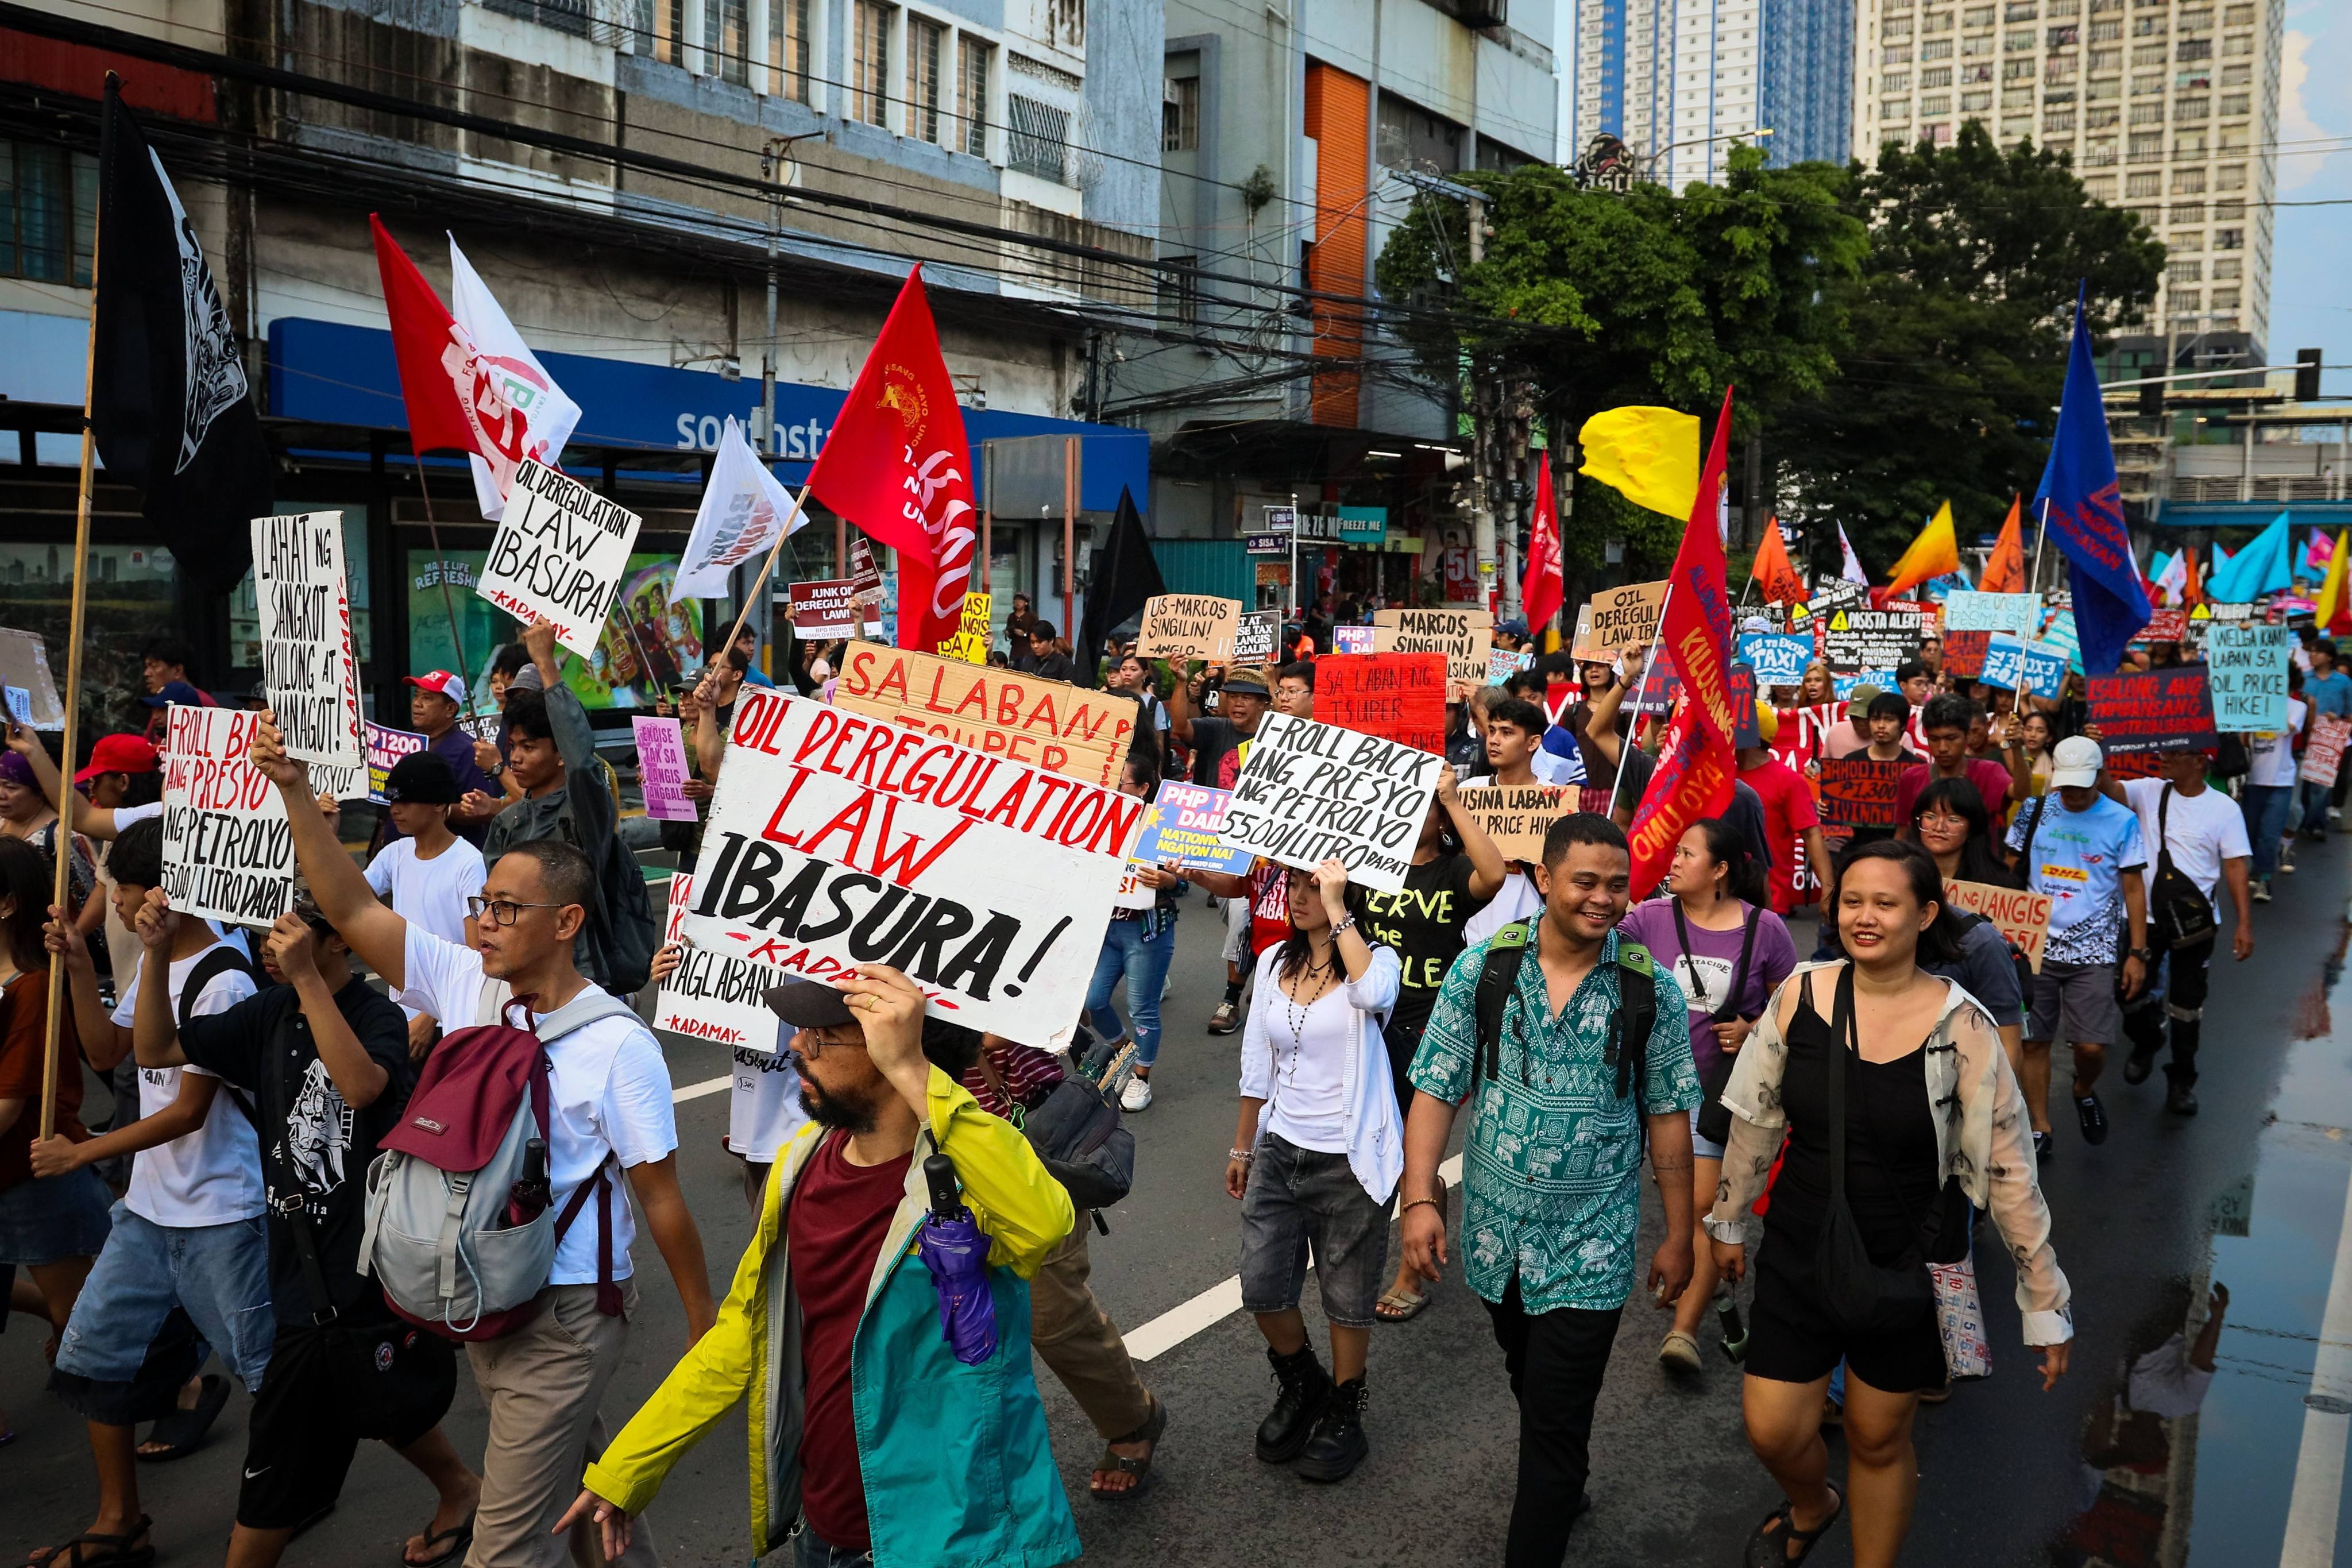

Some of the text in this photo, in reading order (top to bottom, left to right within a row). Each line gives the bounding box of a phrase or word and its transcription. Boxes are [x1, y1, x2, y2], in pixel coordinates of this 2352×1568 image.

[516, 459, 631, 539] OIL DEREGULATION
[521, 495, 603, 561] LAW
[261, 515, 332, 584] LAHAT NG
[1258, 538, 1275, 547] SISA
[423, 561, 470, 573] MAE LIFE
[489, 526, 619, 624] IBASURA!
[812, 586, 839, 598] JUNK
[1614, 590, 1646, 607] OIL
[271, 580, 329, 642] SANGKOT
[822, 609, 850, 620] LAW!
[1848, 612, 1922, 630] PASISTA ALERT
[1148, 618, 1213, 641] SINGILIN!
[1253, 624, 1273, 635] TAX
[1338, 629, 1366, 641] PHP
[1400, 612, 1468, 638] MARCOS
[1392, 636, 1474, 661] SINGILIN!
[1744, 638, 1763, 656] NO
[1779, 637, 1810, 659] EXCISE
[2215, 629, 2257, 647] WELGA
[265, 639, 336, 694] IKULONG AT
[1751, 648, 1797, 671] TAX!
[2212, 649, 2277, 669] LABAN SA
[1324, 666, 1431, 697] SA LABAN NG
[2212, 673, 2285, 695] OIL PRICE
[846, 652, 1110, 742] SA LABAN
[2224, 695, 2270, 717] HIKE!
[272, 683, 342, 754] MANAGOT!
[167, 707, 213, 758] I-ROLL
[381, 732, 422, 754] 1200
[641, 726, 674, 744] EXCISE
[646, 747, 678, 764] TAX SA
[1257, 713, 1437, 786] I-ROLL BACK
[165, 758, 271, 810] ANG PRESYO
[646, 767, 681, 784] LANGIS
[732, 692, 1144, 859] OIL DEREGULATION
[1243, 747, 1426, 818] ANG PRESYO
[644, 785, 690, 801] TANGGALI
[1162, 785, 1210, 809] PHP
[1508, 789, 1562, 810] LABAN
[1235, 778, 1412, 848] NG PETROLYO
[760, 764, 984, 890] LAW
[1486, 814, 1525, 836] PRICE
[164, 805, 291, 871] NG PETROLYO
[1155, 840, 1235, 860] NGAYON NA!
[1189, 860, 1224, 870] MAYO UNO
[1364, 850, 1410, 877] DAPAT
[238, 874, 293, 920] DAPAT
[1366, 888, 1454, 924] ERVE
[1962, 890, 2048, 926] NG LANGIS
[689, 832, 1073, 1002] IBASURA!
[1949, 1277, 1963, 1291] 10
[1967, 1301, 1977, 1311] 4
[1963, 1321, 1976, 1331] 5
